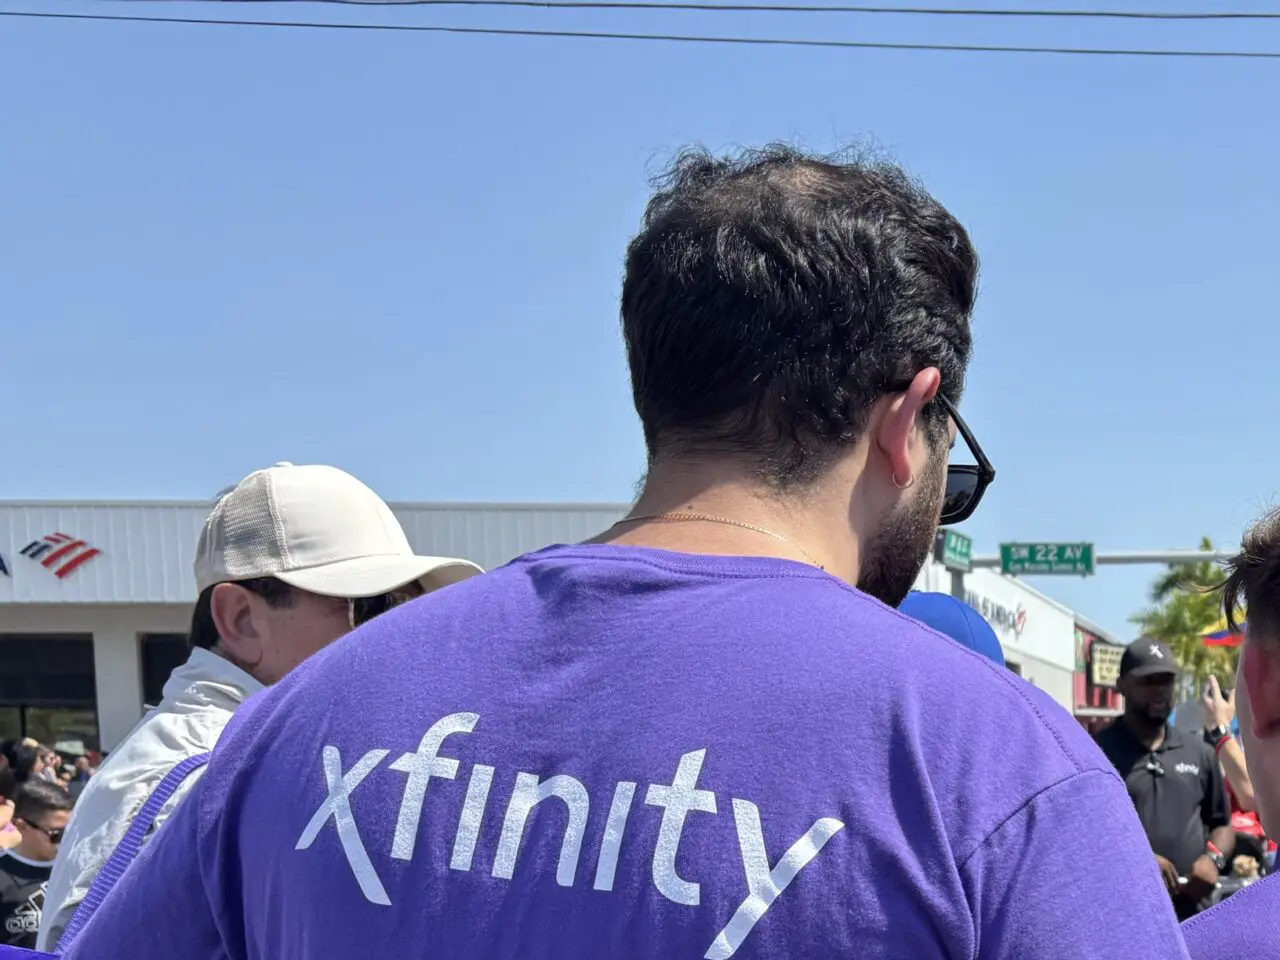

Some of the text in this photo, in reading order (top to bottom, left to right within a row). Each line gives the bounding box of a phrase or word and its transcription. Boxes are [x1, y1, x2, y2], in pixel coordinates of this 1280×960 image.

[1035, 544, 1059, 561] 22
[1064, 545, 1084, 560] AV
[295, 711, 845, 960] xfinity
